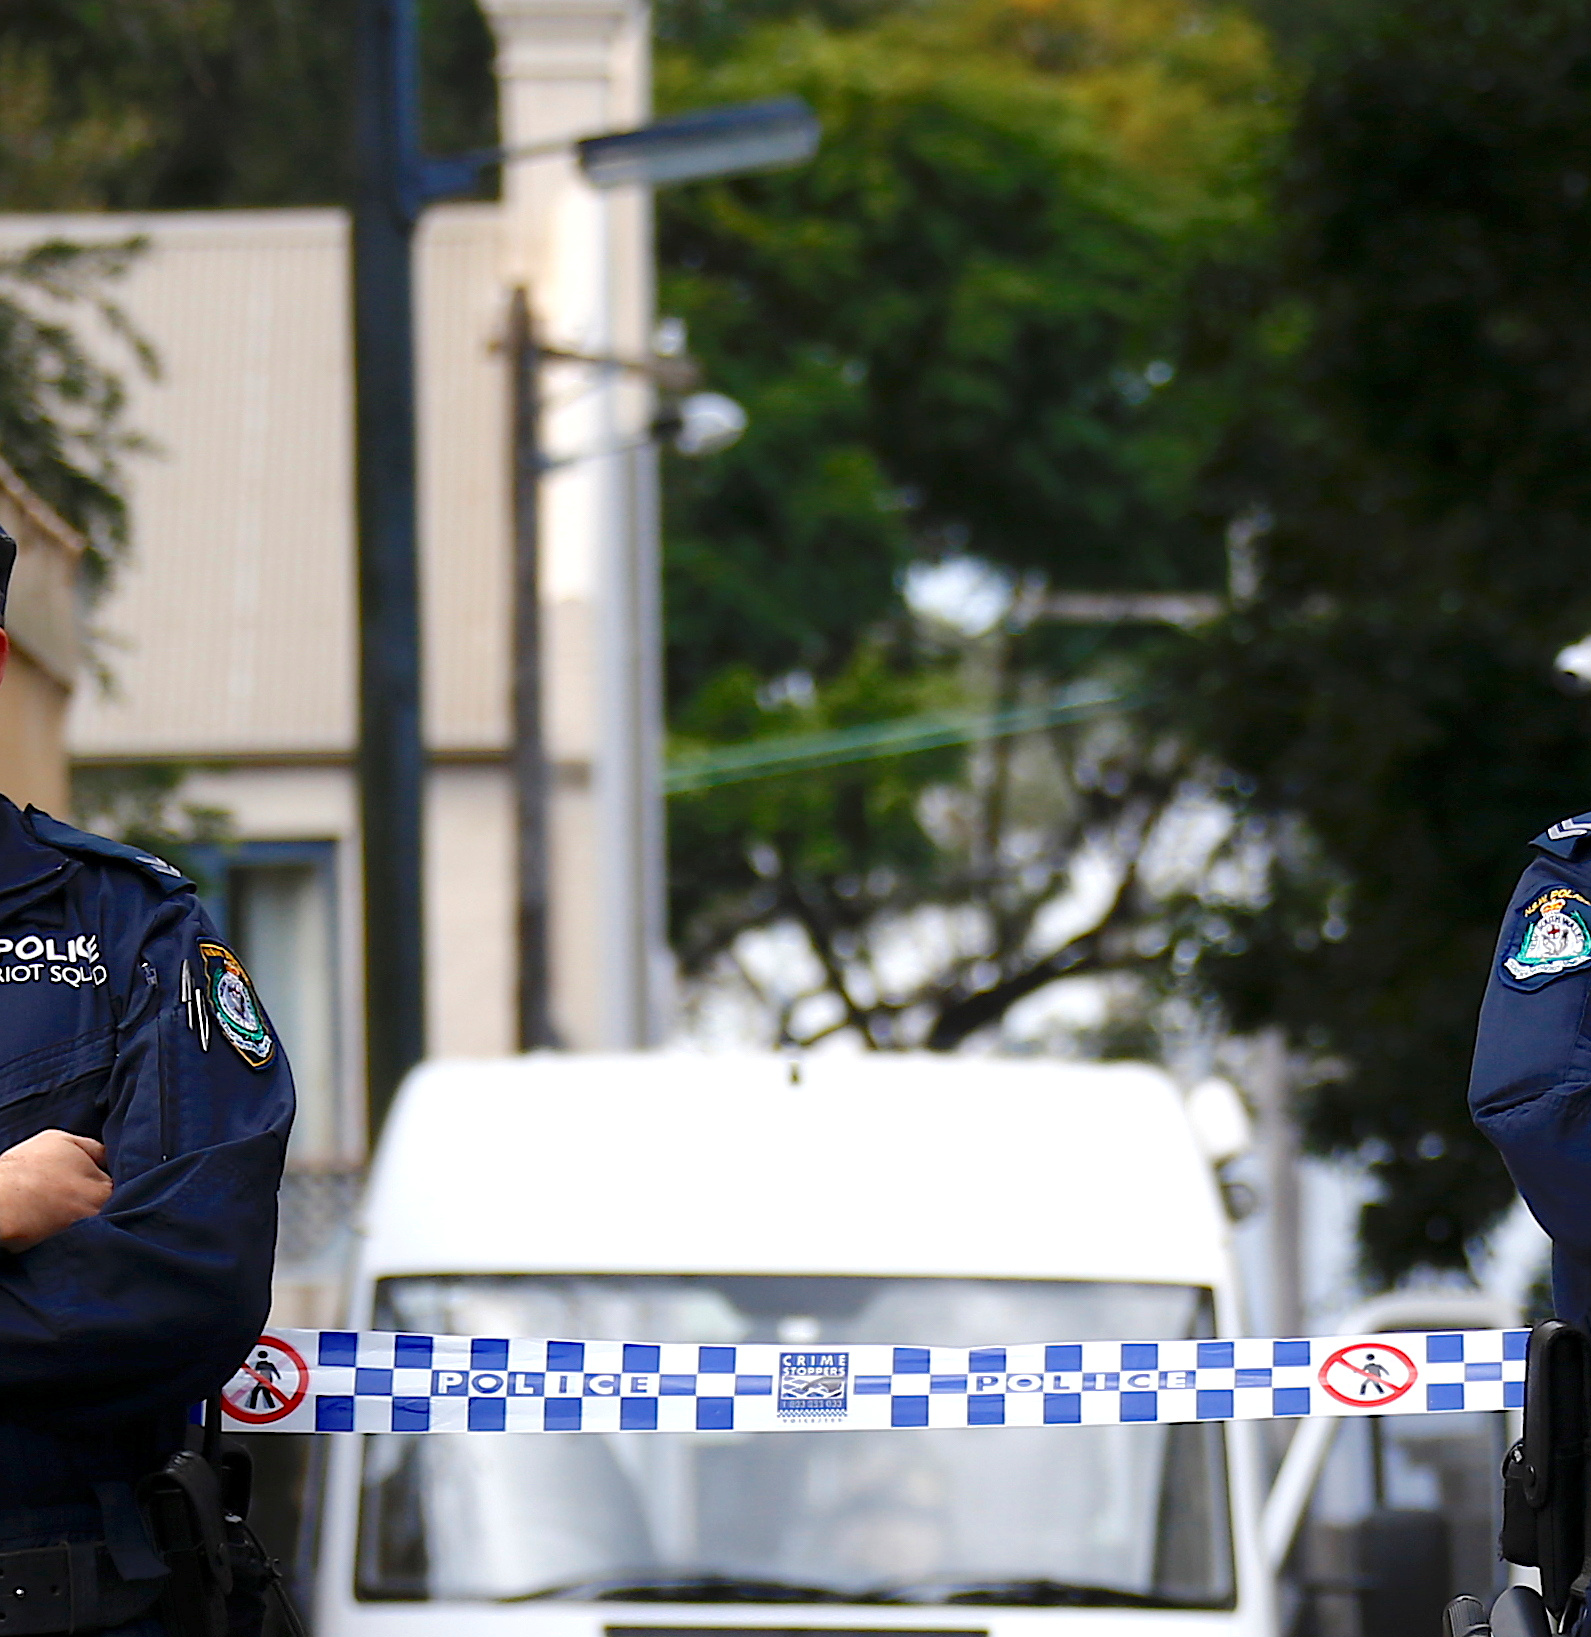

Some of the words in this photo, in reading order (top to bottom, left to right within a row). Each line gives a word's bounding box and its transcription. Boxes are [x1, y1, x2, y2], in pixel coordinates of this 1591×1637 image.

[49, 964, 107, 988] SQUD
[782, 1354, 847, 1367] CRIME
[782, 1366, 847, 1377] STOPPERS
[437, 1371, 650, 1396] POLICE
[975, 1371, 1187, 1395] POLICE
